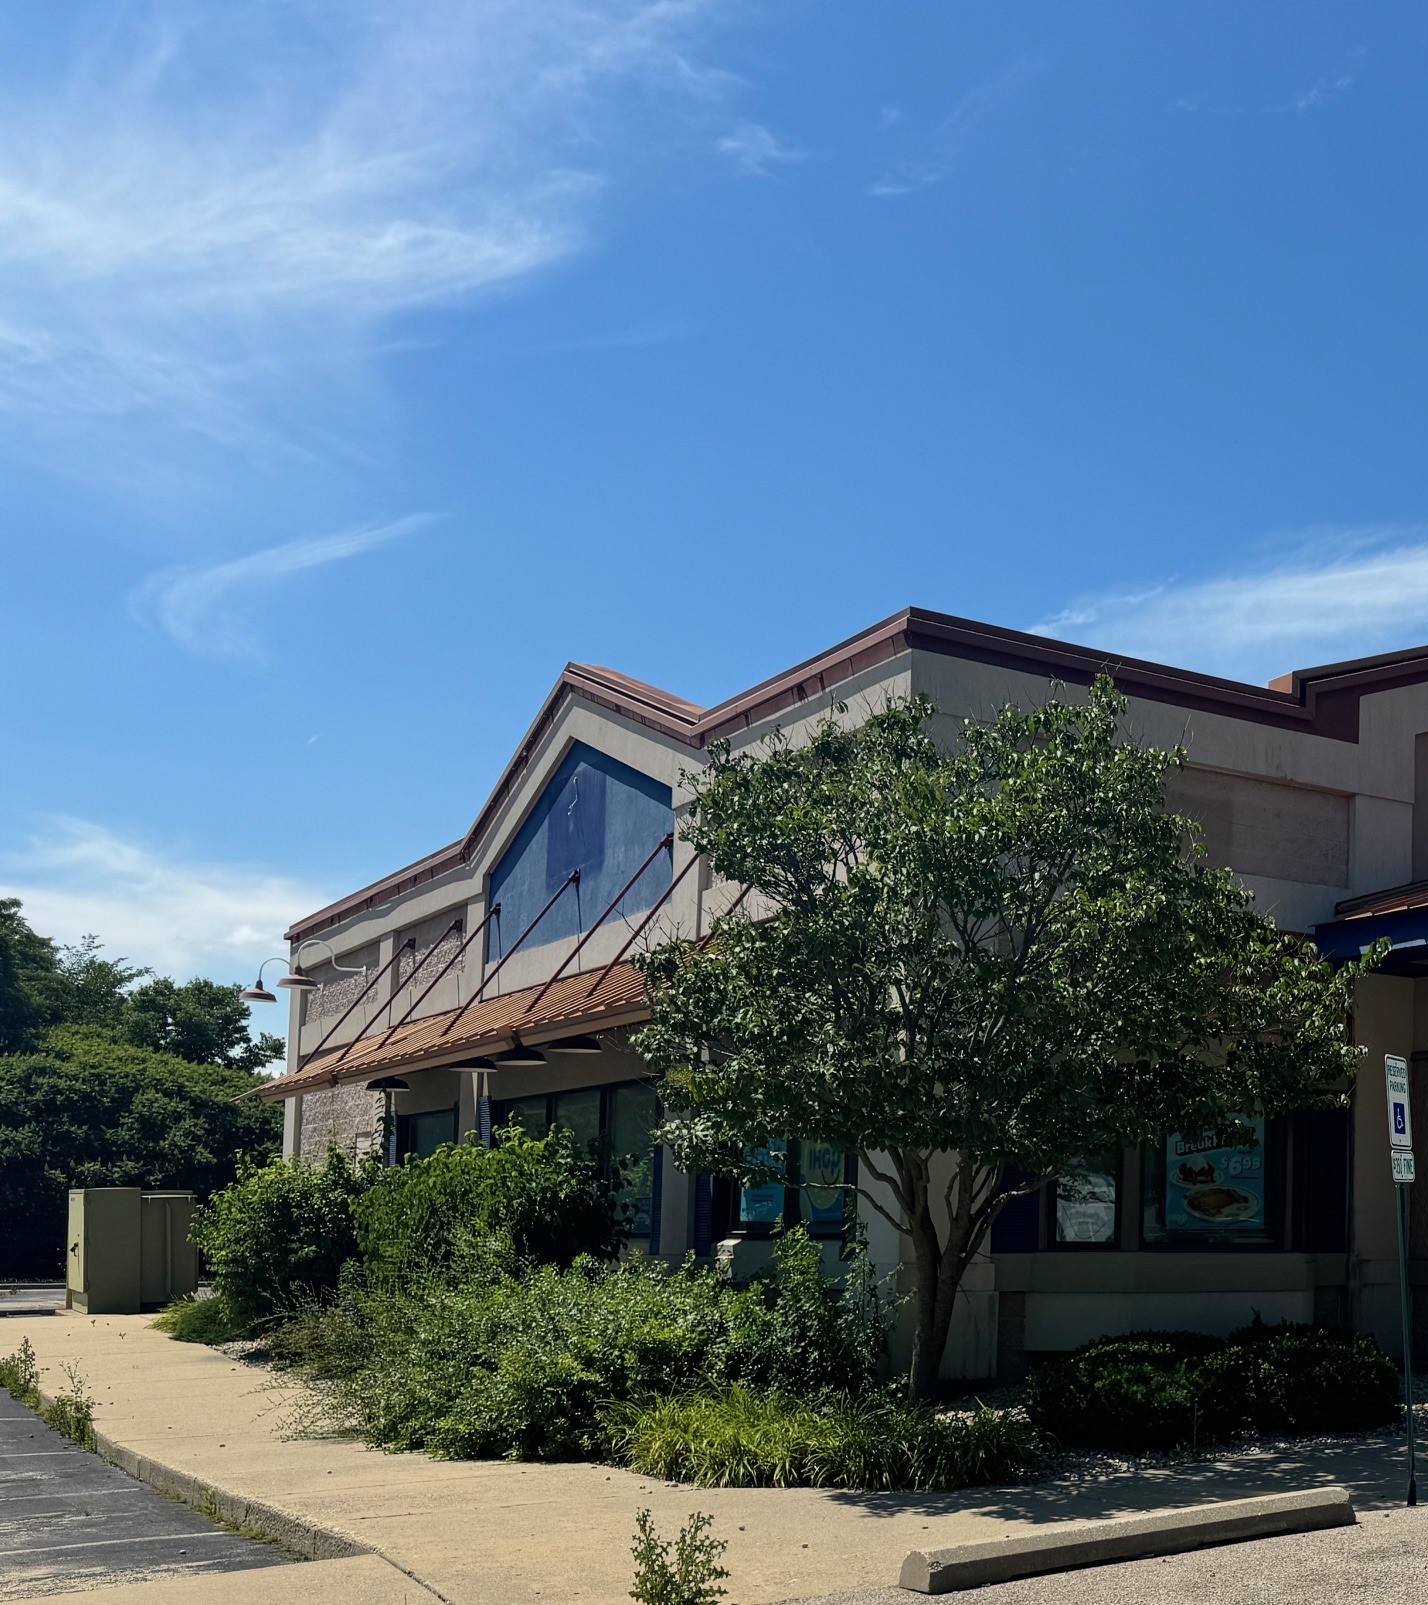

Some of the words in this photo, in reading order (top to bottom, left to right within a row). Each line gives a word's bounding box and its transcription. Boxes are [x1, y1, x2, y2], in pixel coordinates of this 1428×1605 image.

[1387, 1064, 1406, 1079] RESERVED
[1389, 1080, 1406, 1094] PARKING
[1403, 1158, 1414, 1175] FINE
